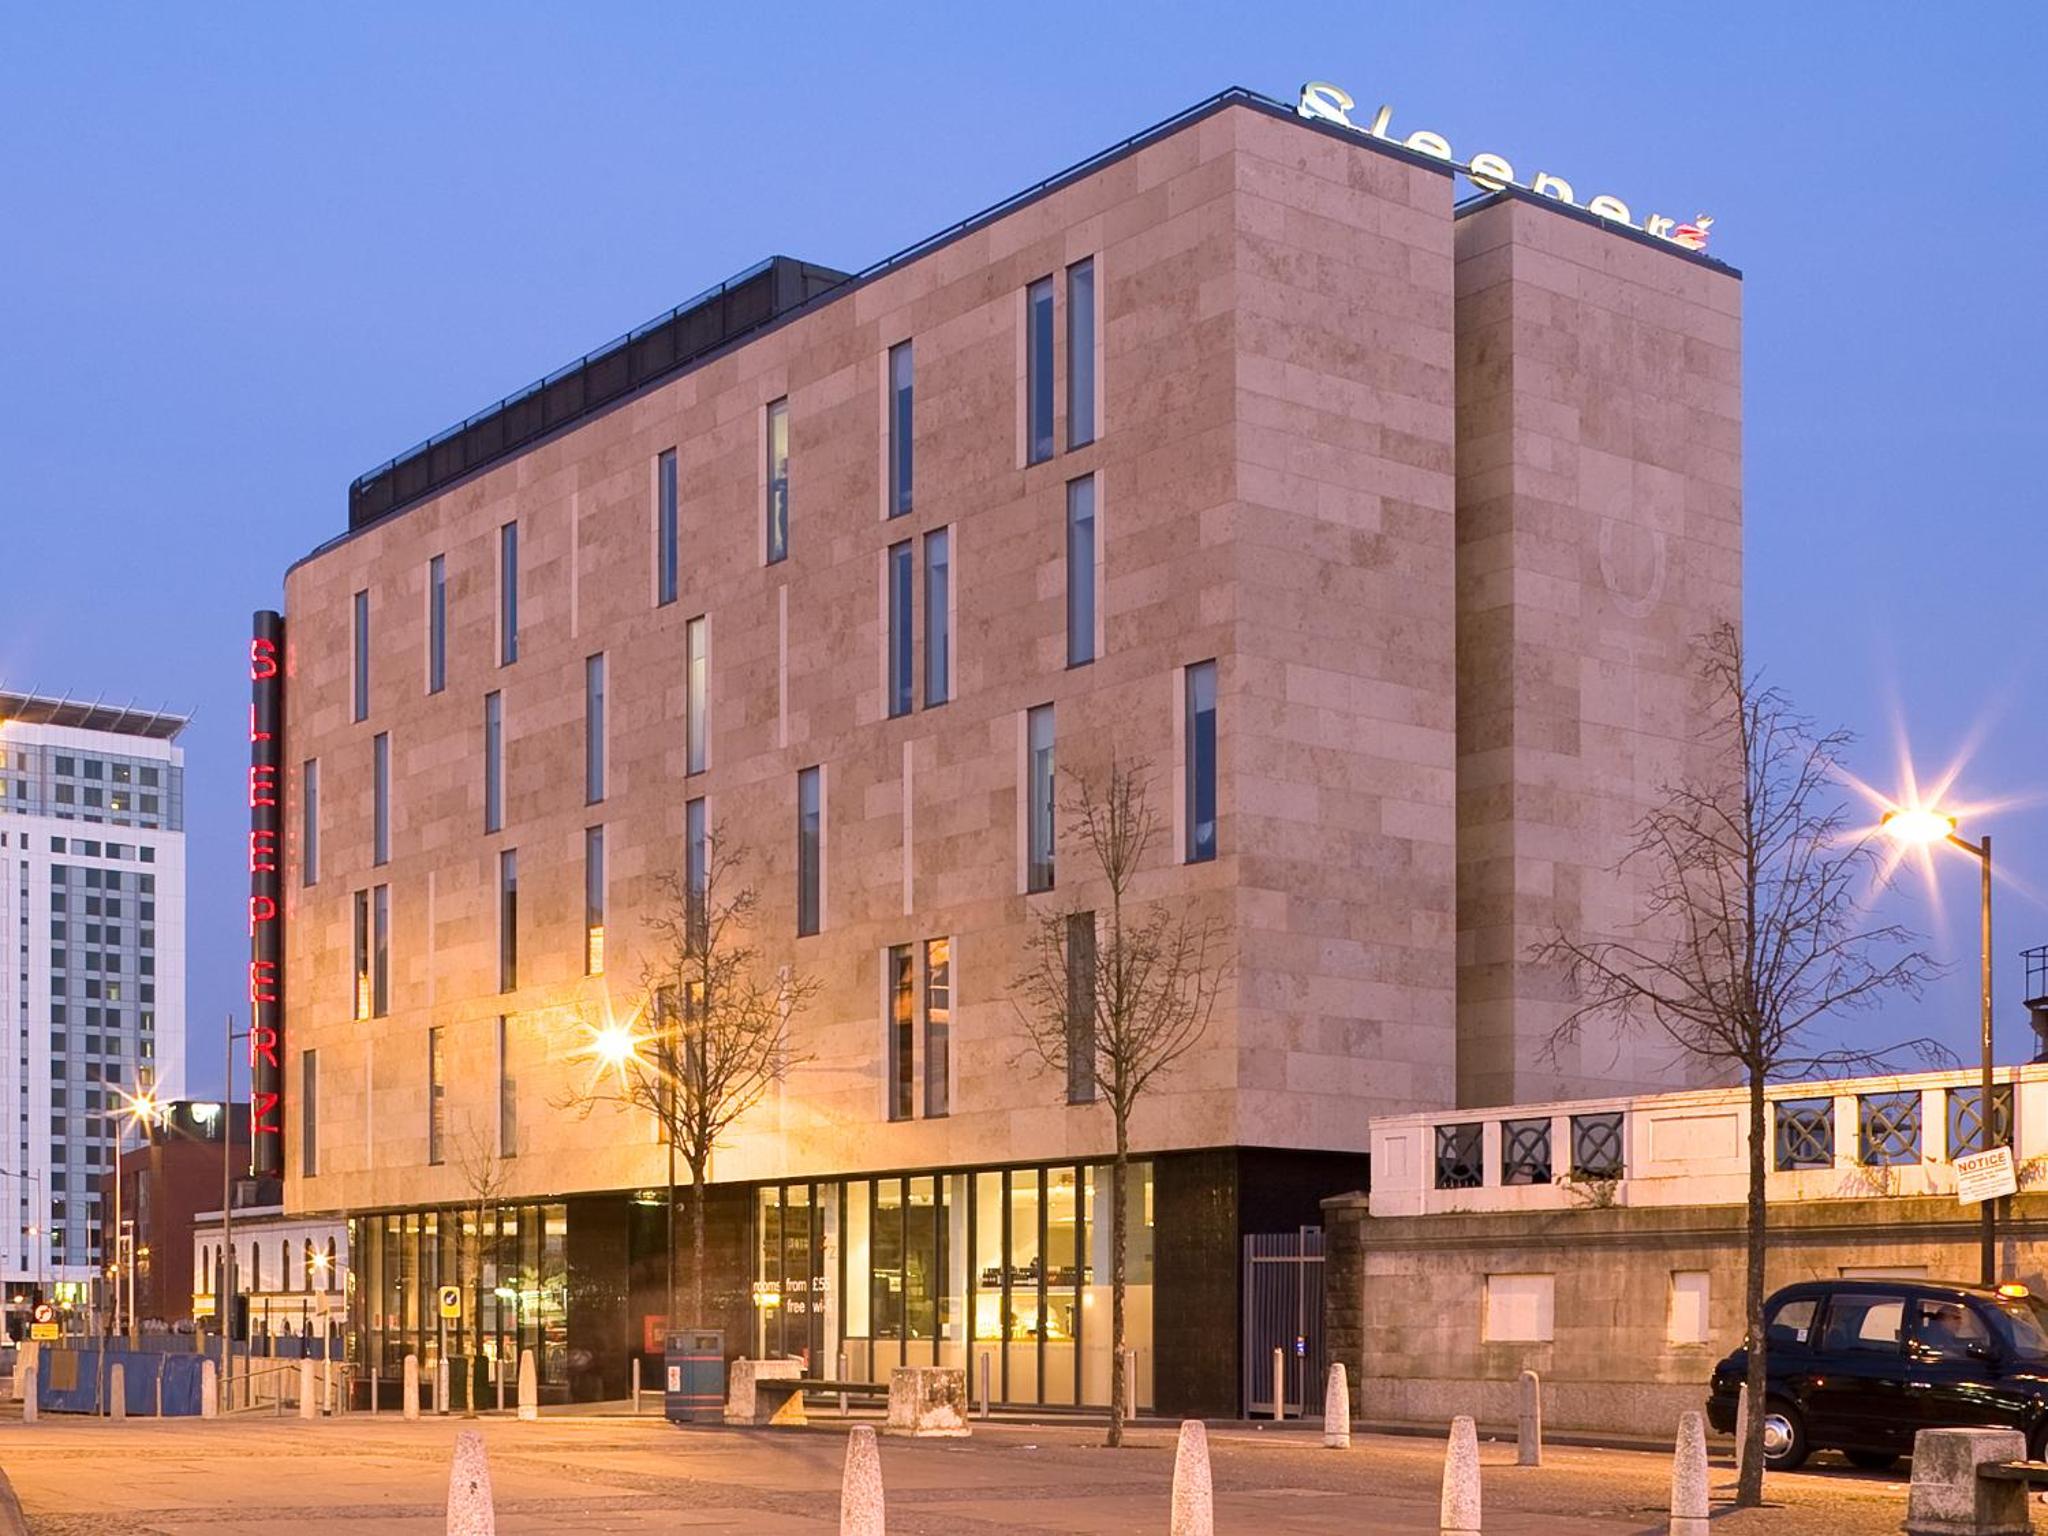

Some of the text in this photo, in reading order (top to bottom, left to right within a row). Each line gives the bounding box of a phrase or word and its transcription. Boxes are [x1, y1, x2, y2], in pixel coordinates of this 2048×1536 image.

[248, 637, 277, 1134] SLEEPERZ
[1958, 1152, 2005, 1171] NOTICE
[753, 1281, 780, 1291] rooms
[786, 1278, 807, 1291] from
[787, 1299, 805, 1313] free
